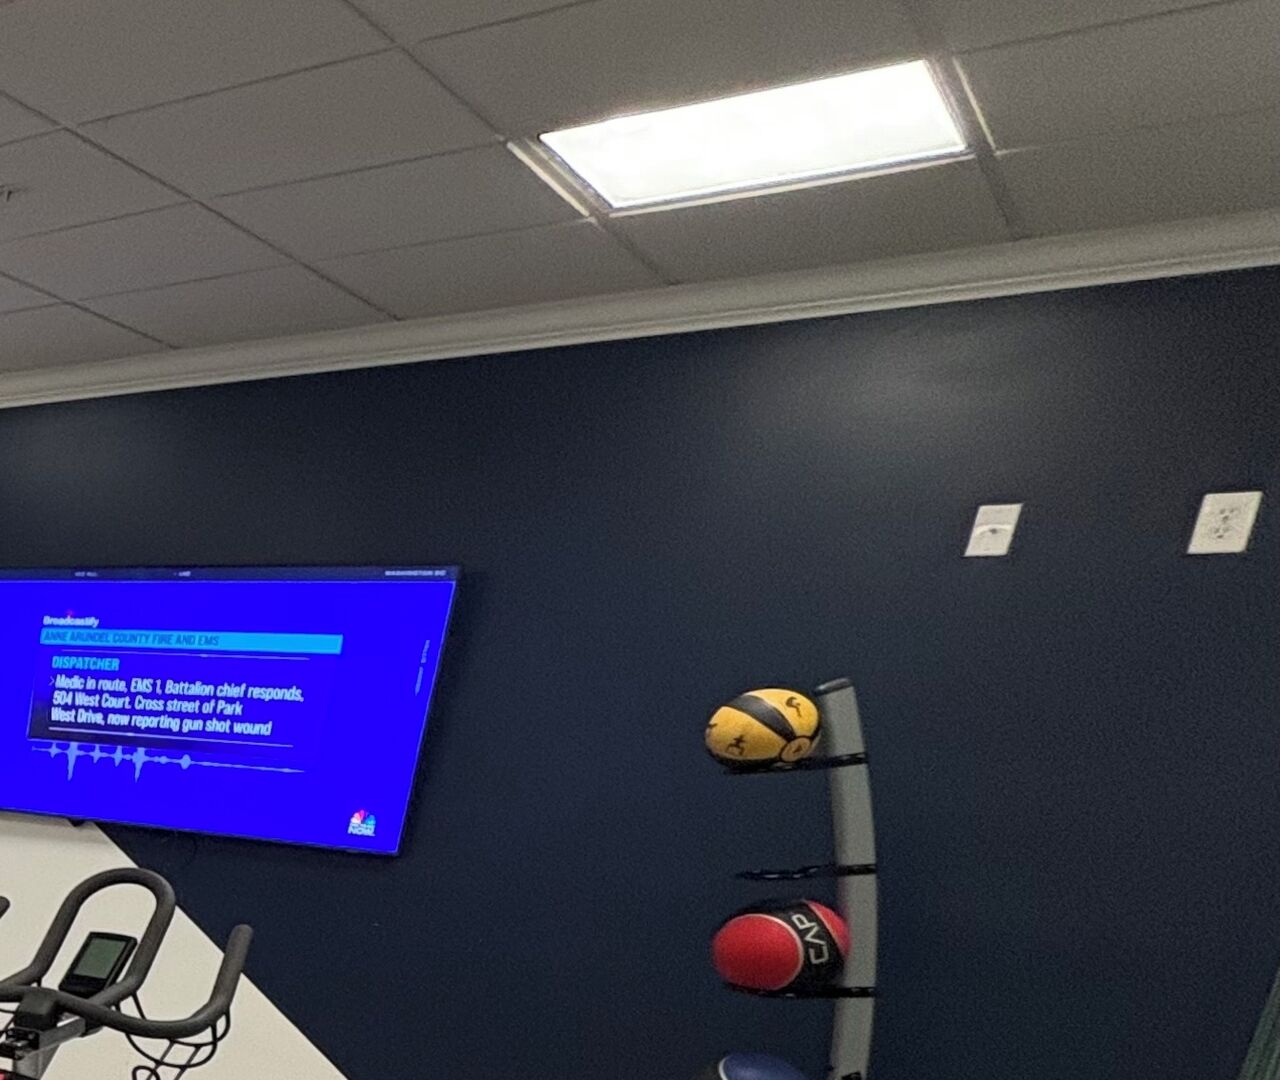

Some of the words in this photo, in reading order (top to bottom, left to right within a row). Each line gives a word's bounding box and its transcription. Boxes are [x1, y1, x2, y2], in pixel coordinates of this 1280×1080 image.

[44, 615, 99, 627] Broadcastify
[43, 631, 67, 641] ANNE
[69, 632, 110, 642] ARUNDEL
[112, 633, 150, 644] COUNTY
[152, 634, 174, 644] FIRE
[175, 635, 196, 645] AND
[197, 636, 219, 646] EMS
[52, 657, 119, 670] DISPATCHER
[55, 674, 84, 688] Medic
[86, 677, 95, 689] in
[98, 679, 127, 692] route,
[131, 678, 153, 692] EMS
[156, 680, 162, 694] 1,
[165, 680, 214, 695] Battalion
[217, 683, 246, 697] chief
[248, 686, 304, 701] responds,
[53, 691, 73, 704] 504
[74, 692, 99, 706] West
[102, 693, 131, 708] Court.
[135, 695, 164, 710] Cross
[166, 699, 199, 713] street
[202, 700, 215, 713] of
[217, 700, 242, 715] Park
[51, 707, 76, 722] West
[77, 709, 105, 725] Drive,
[107, 714, 130, 725] now
[131, 715, 180, 731] reporting
[182, 719, 203, 732] gun
[205, 719, 230, 733] shot
[234, 722, 272, 735] wound
[790, 912, 830, 965] CAP
